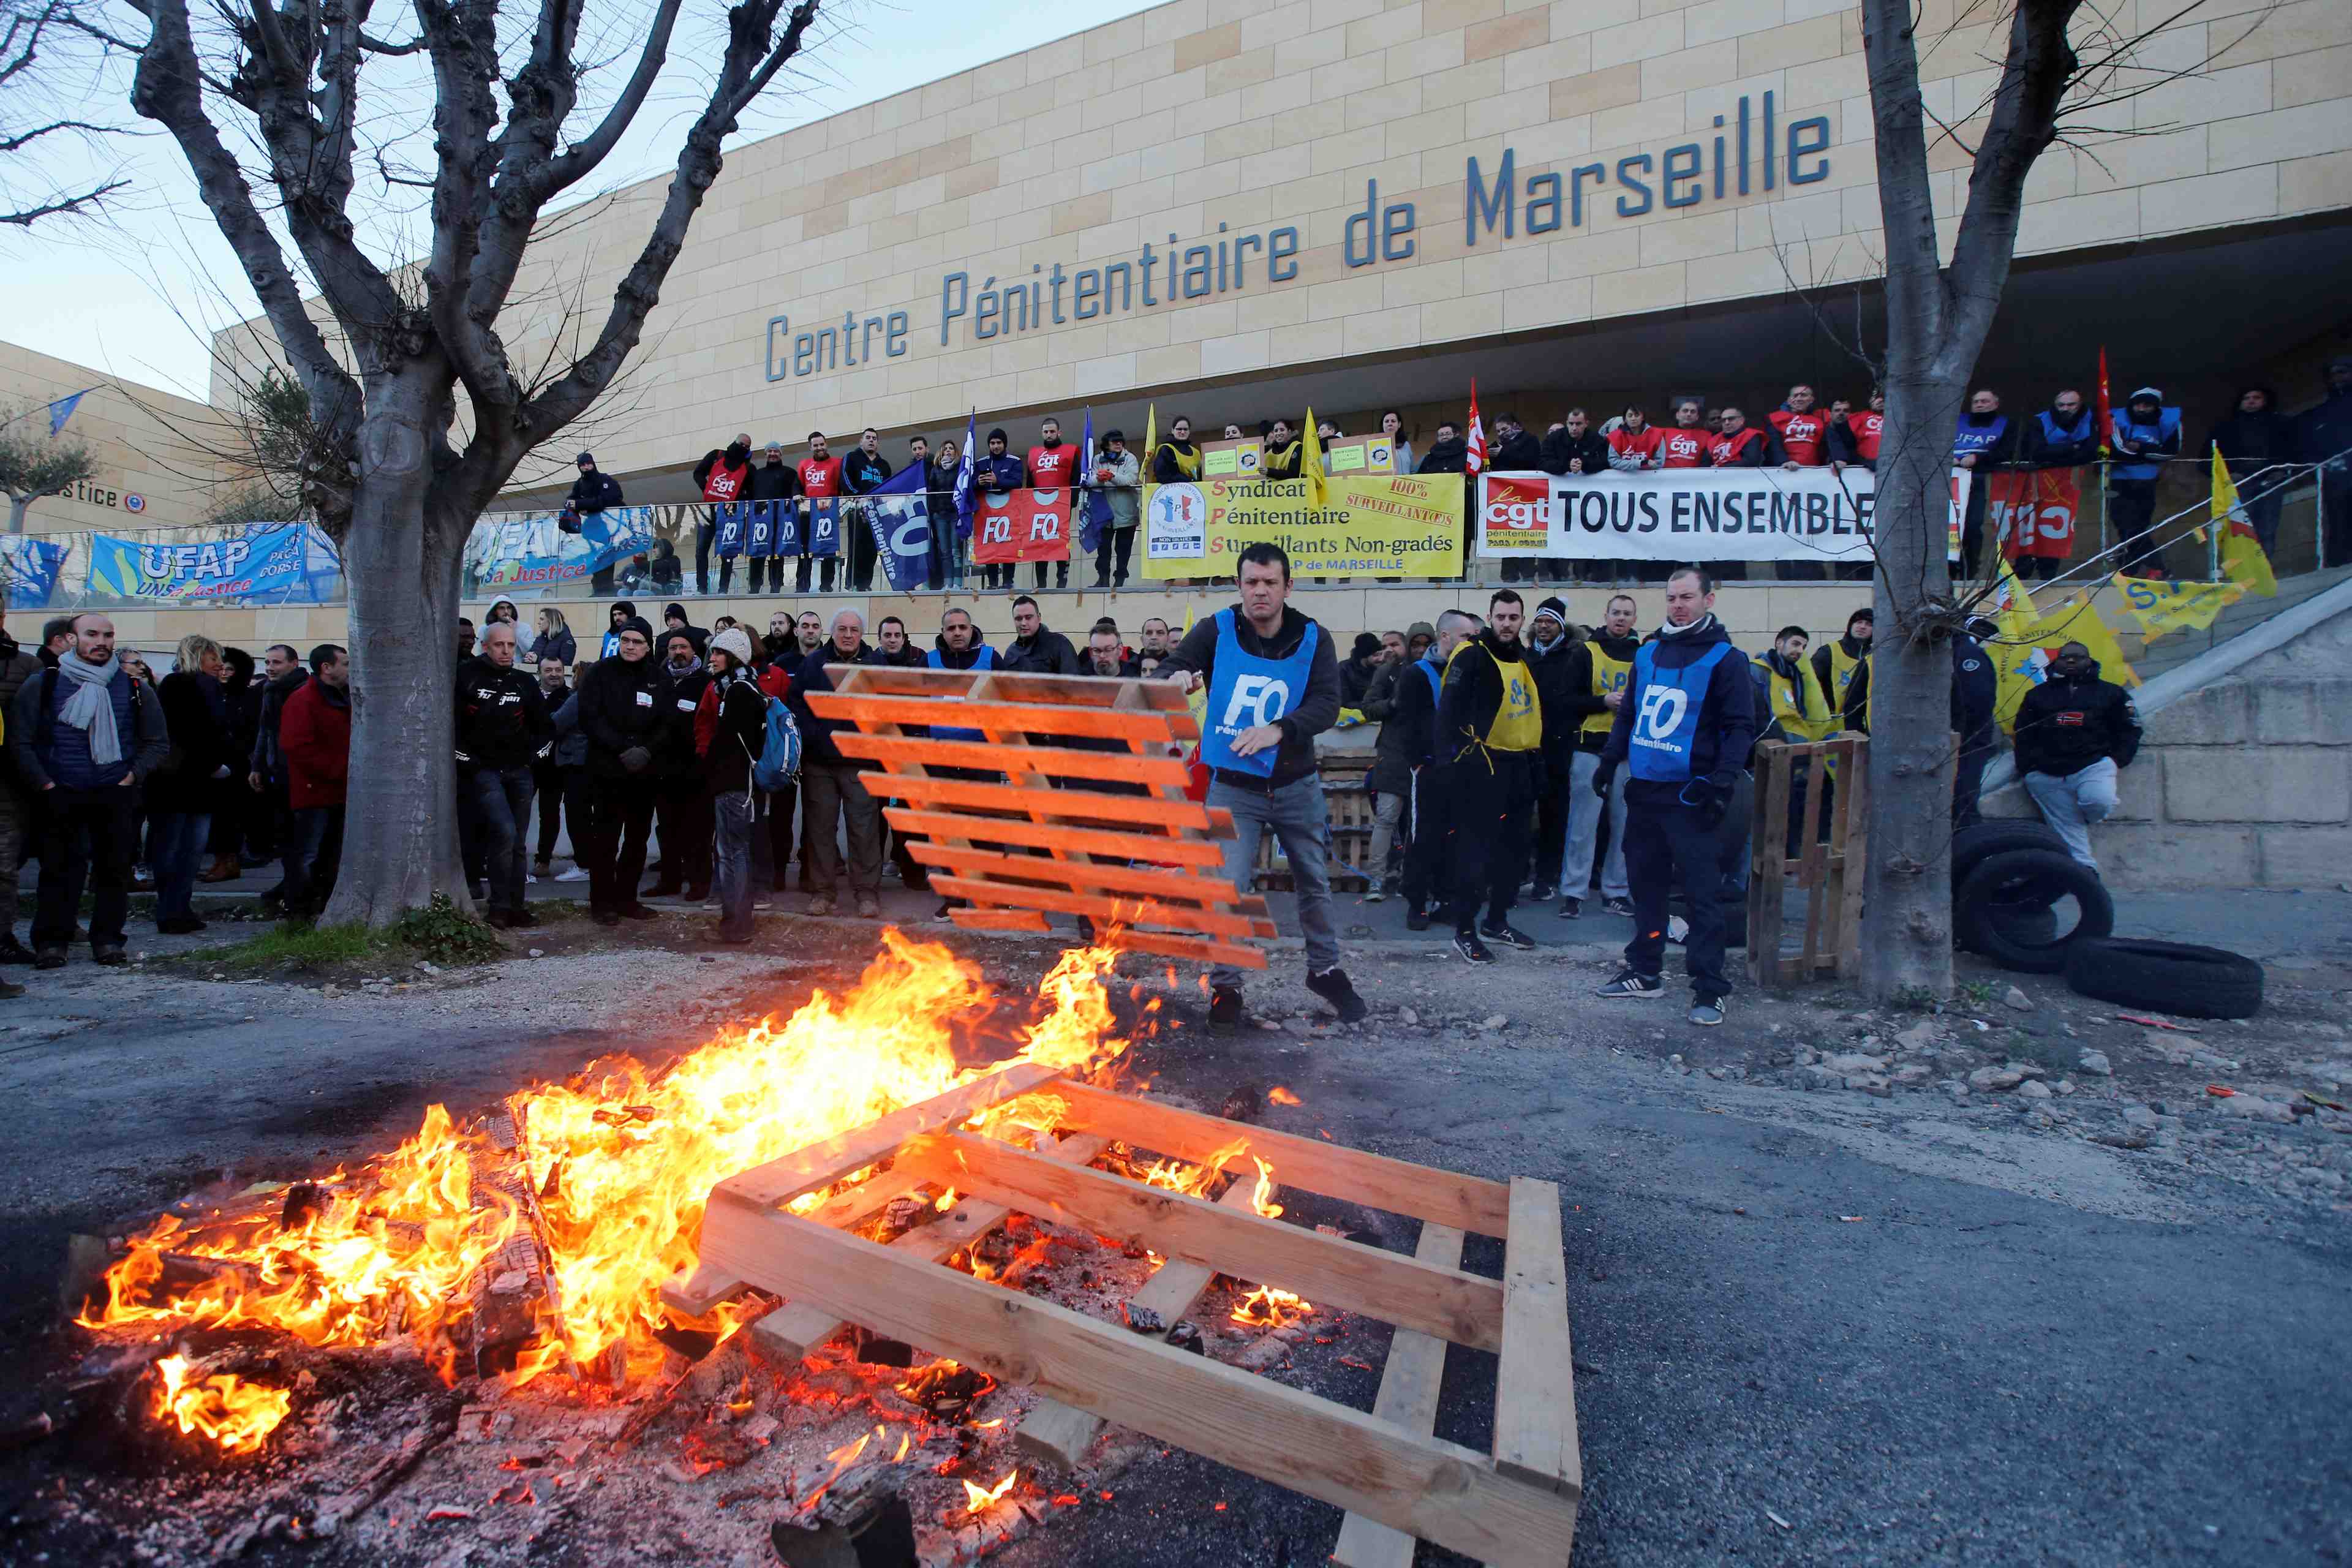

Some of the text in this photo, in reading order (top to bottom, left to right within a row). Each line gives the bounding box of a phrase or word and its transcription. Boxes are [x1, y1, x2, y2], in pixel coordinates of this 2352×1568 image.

[766, 89, 1830, 382] Centre Pénitentiaire de Marseille
[1670, 440, 1698, 454] cgt
[1037, 454, 1059, 468] cgt
[712, 475, 736, 492] cgt
[805, 469, 826, 484] cgt
[63, 481, 117, 507] stice
[1212, 480, 1306, 502] Syndicat
[1391, 479, 1428, 497] 100%
[1490, 486, 1536, 503] la
[1210, 507, 1350, 525] Pénitentiaire
[1346, 493, 1452, 526] SURVEILLANT(E)S
[1487, 497, 1549, 529] cgt
[1558, 491, 1875, 535] TOUS ENSEMBLE
[1345, 536, 1453, 556] Non-gradés
[143, 540, 251, 580] UFAP
[259, 559, 302, 578] CORSE
[1306, 559, 1322, 570] de
[1327, 559, 1403, 570] MARSEILLE
[510, 562, 587, 583] Justice
[1223, 674, 1289, 728] FO
[1635, 684, 1687, 739] FO
